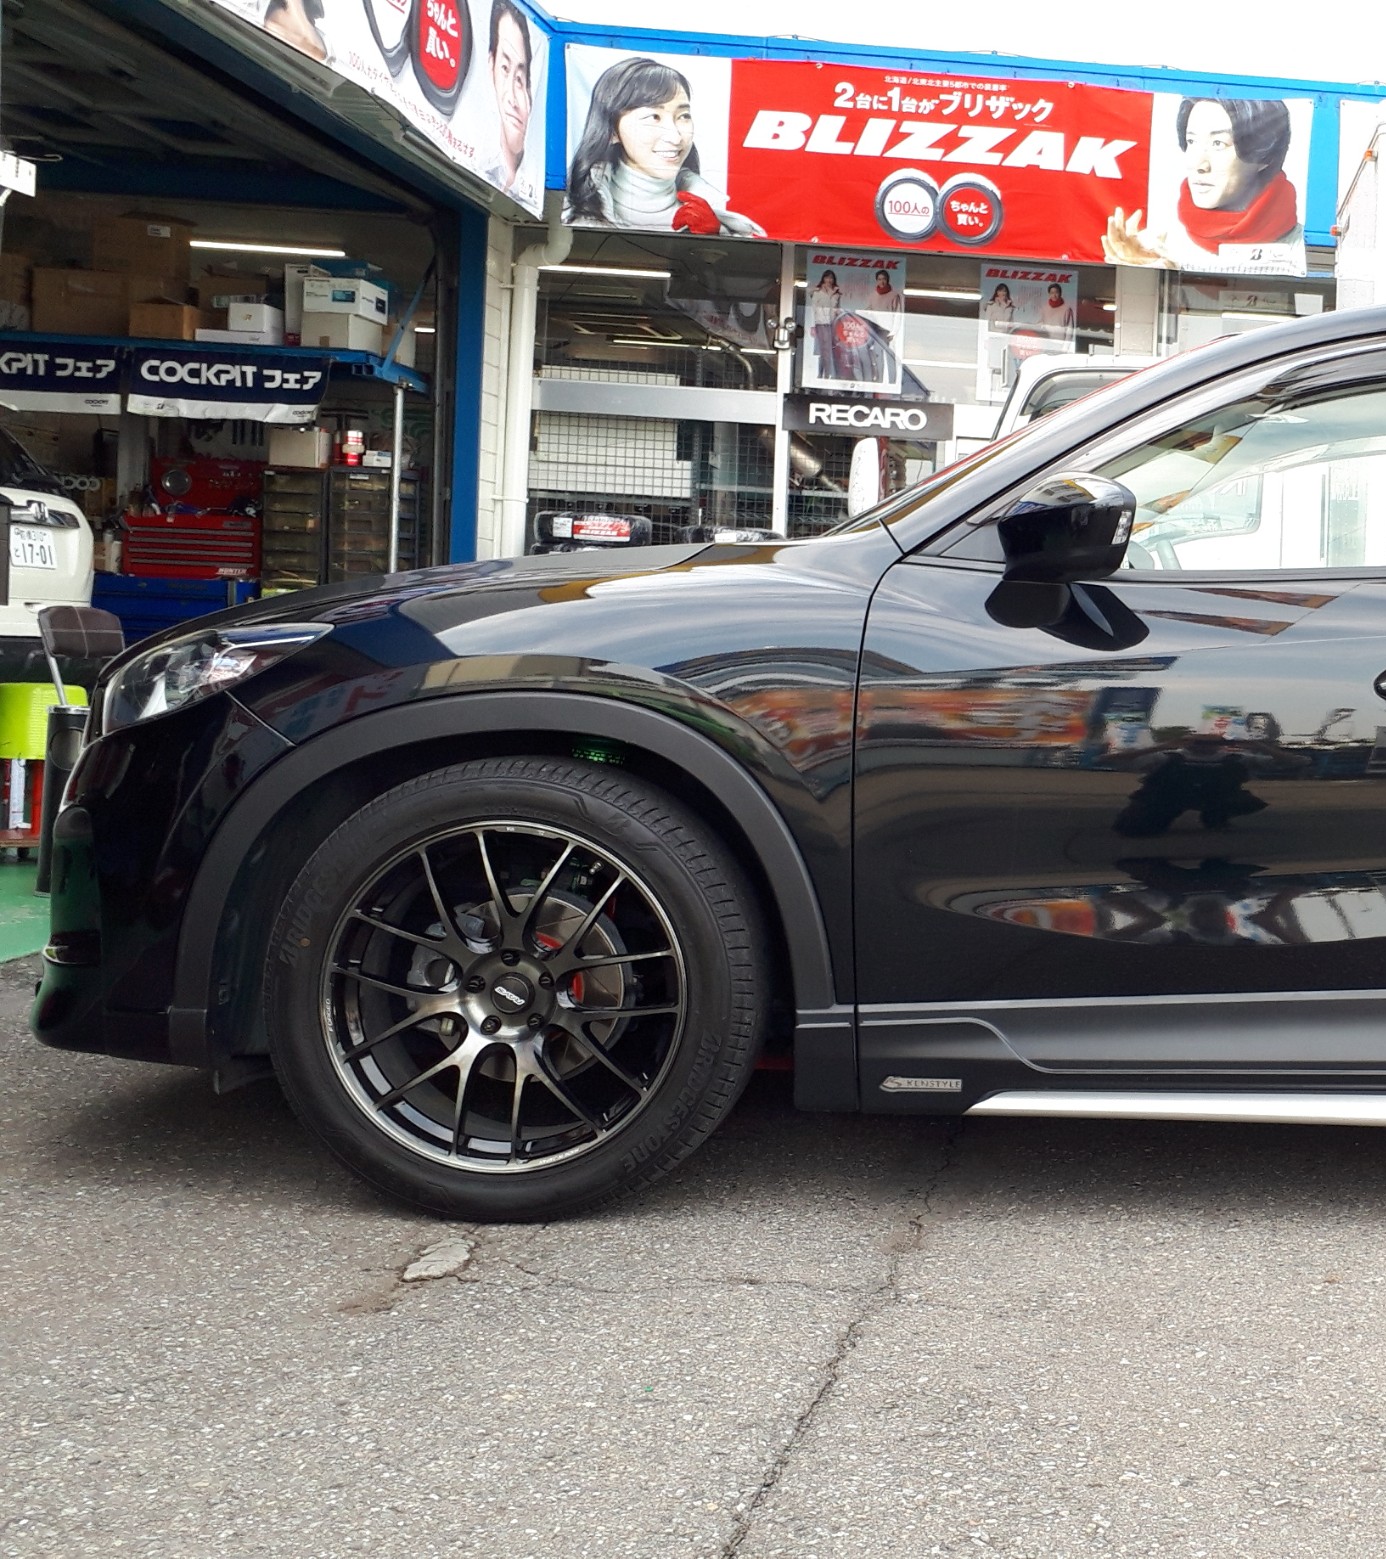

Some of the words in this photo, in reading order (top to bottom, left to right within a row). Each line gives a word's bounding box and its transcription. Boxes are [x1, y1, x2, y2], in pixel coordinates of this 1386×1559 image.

[427, 0, 459, 38] ちゃんと
[425, 26, 456, 68] 買い。
[833, 81, 1054, 123] 2台に1台がブリザック
[742, 110, 1138, 179] BLIZZAK
[888, 200, 930, 215] 100人の
[950, 200, 989, 214] ちゃんと
[957, 213, 984, 227] 買い。
[812, 254, 901, 270] BLIZZAK
[985, 268, 1073, 284] BLIZZAK
[55, 357, 117, 379] フェア
[140, 358, 258, 388] COCKPIT
[261, 368, 323, 390] フェア
[808, 402, 928, 431] RECARO
[906, 1079, 961, 1088] KENSTYLE
